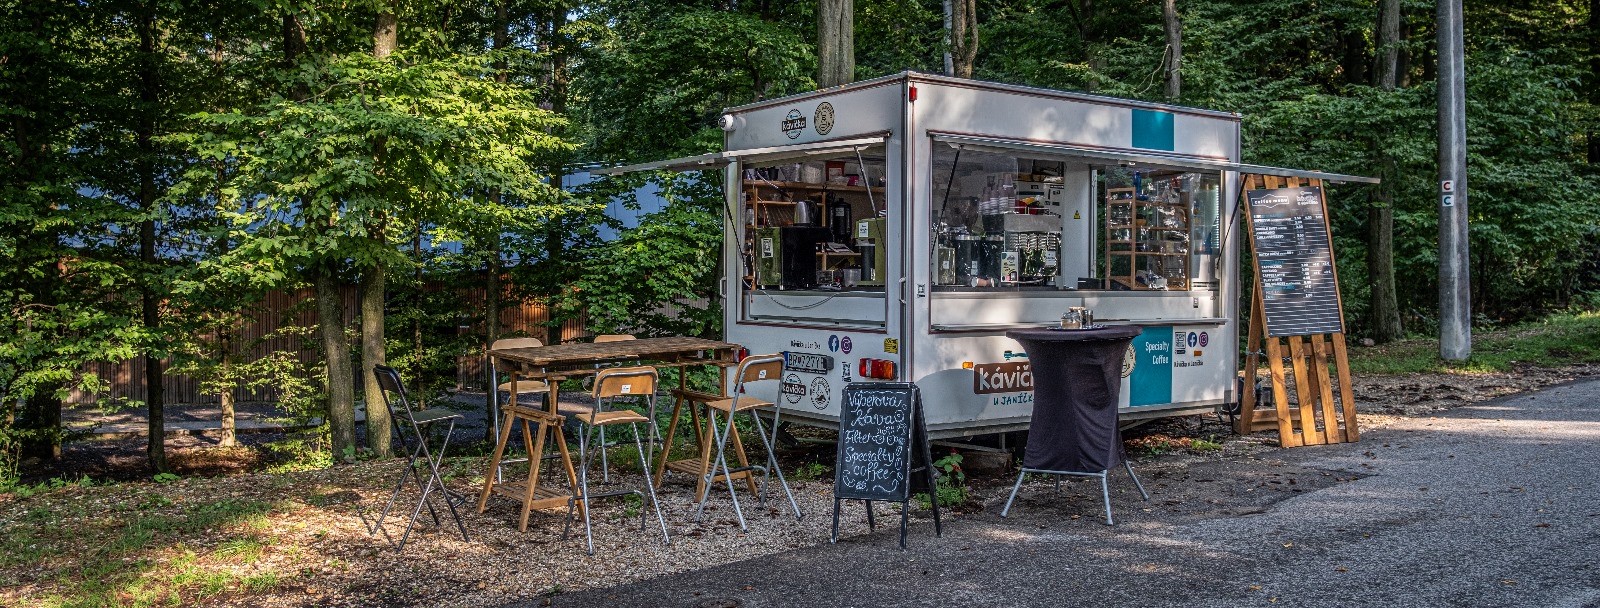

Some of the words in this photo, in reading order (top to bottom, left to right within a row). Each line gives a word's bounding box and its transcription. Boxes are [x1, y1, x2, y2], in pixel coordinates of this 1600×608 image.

[1443, 182, 1451, 190] C
[1444, 196, 1452, 205] C
[1145, 341, 1170, 353] Specialty
[1152, 354, 1169, 365] Coffee
[1001, 393, 1034, 406] JANÍČK
[845, 430, 872, 444] Filter
[845, 447, 895, 466] Specialty
[853, 462, 889, 481] coffee
